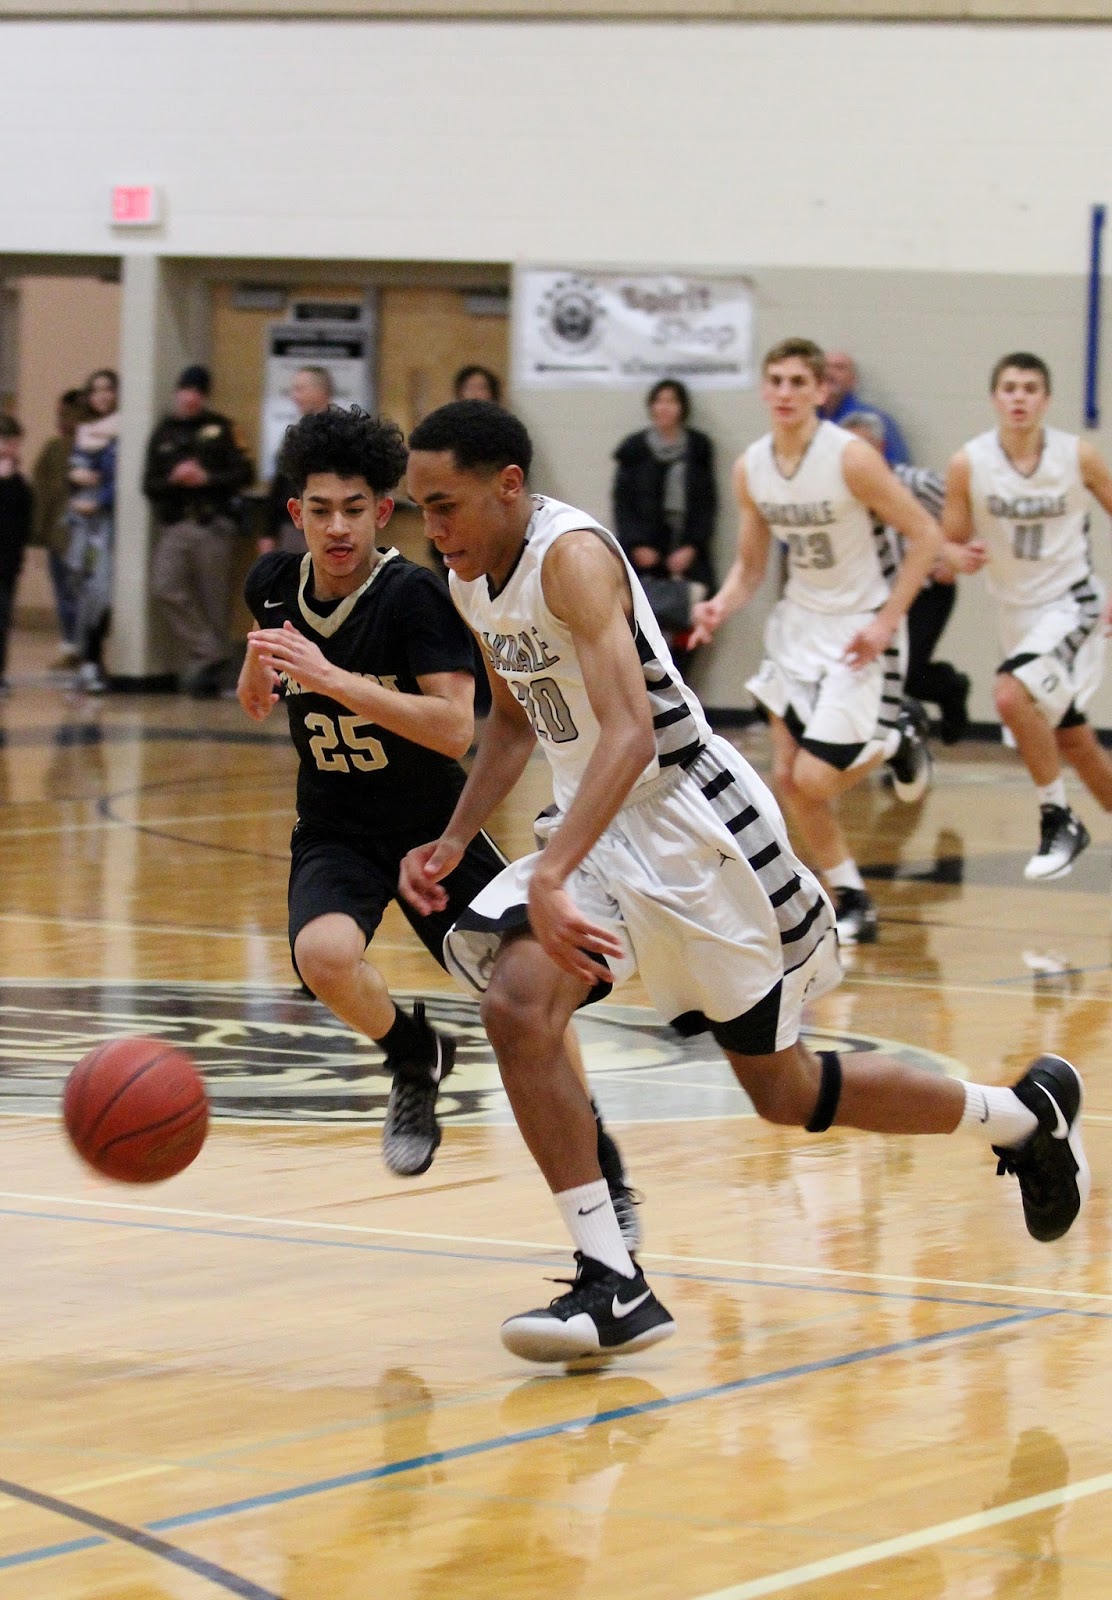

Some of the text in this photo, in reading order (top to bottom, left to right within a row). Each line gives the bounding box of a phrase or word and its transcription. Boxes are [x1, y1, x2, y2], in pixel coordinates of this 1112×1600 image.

[1014, 523, 1044, 561] 11
[482, 626, 560, 673] AKDALE
[304, 712, 389, 773] 25
